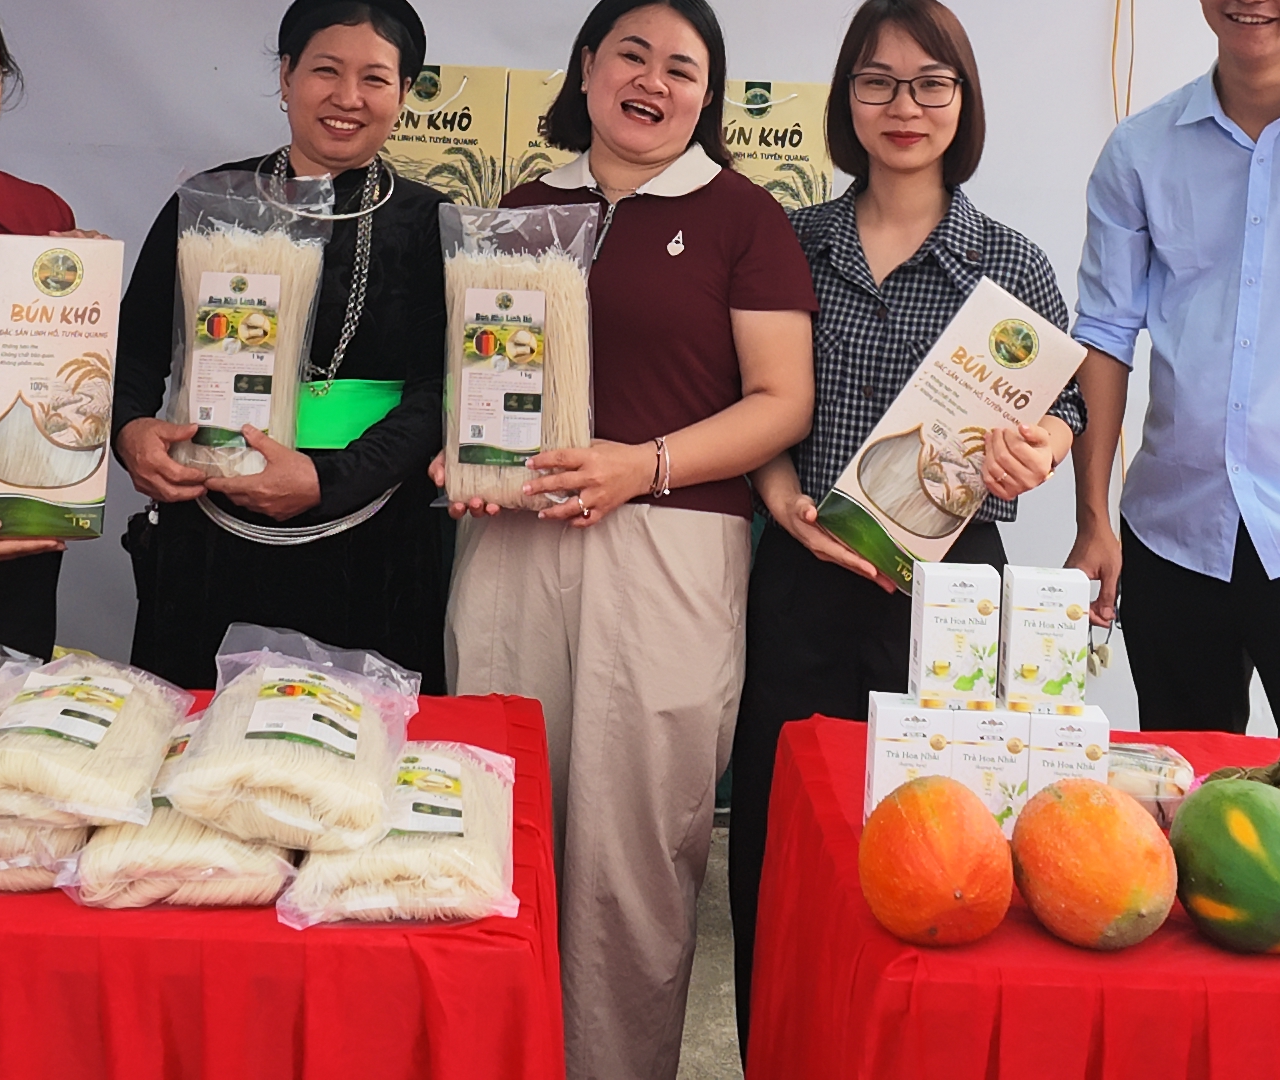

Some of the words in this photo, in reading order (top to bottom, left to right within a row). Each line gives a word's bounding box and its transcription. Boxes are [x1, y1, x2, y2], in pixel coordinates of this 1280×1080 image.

[427, 106, 472, 132] KHÔ
[723, 119, 753, 146] ÚN
[758, 122, 803, 149] KHÔ
[10, 299, 55, 323] BÚN
[60, 300, 101, 326] KHÔ
[949, 345, 993, 383] BÚN
[989, 376, 1033, 410] KHÔ
[1002, 411, 1021, 427] QUAN
